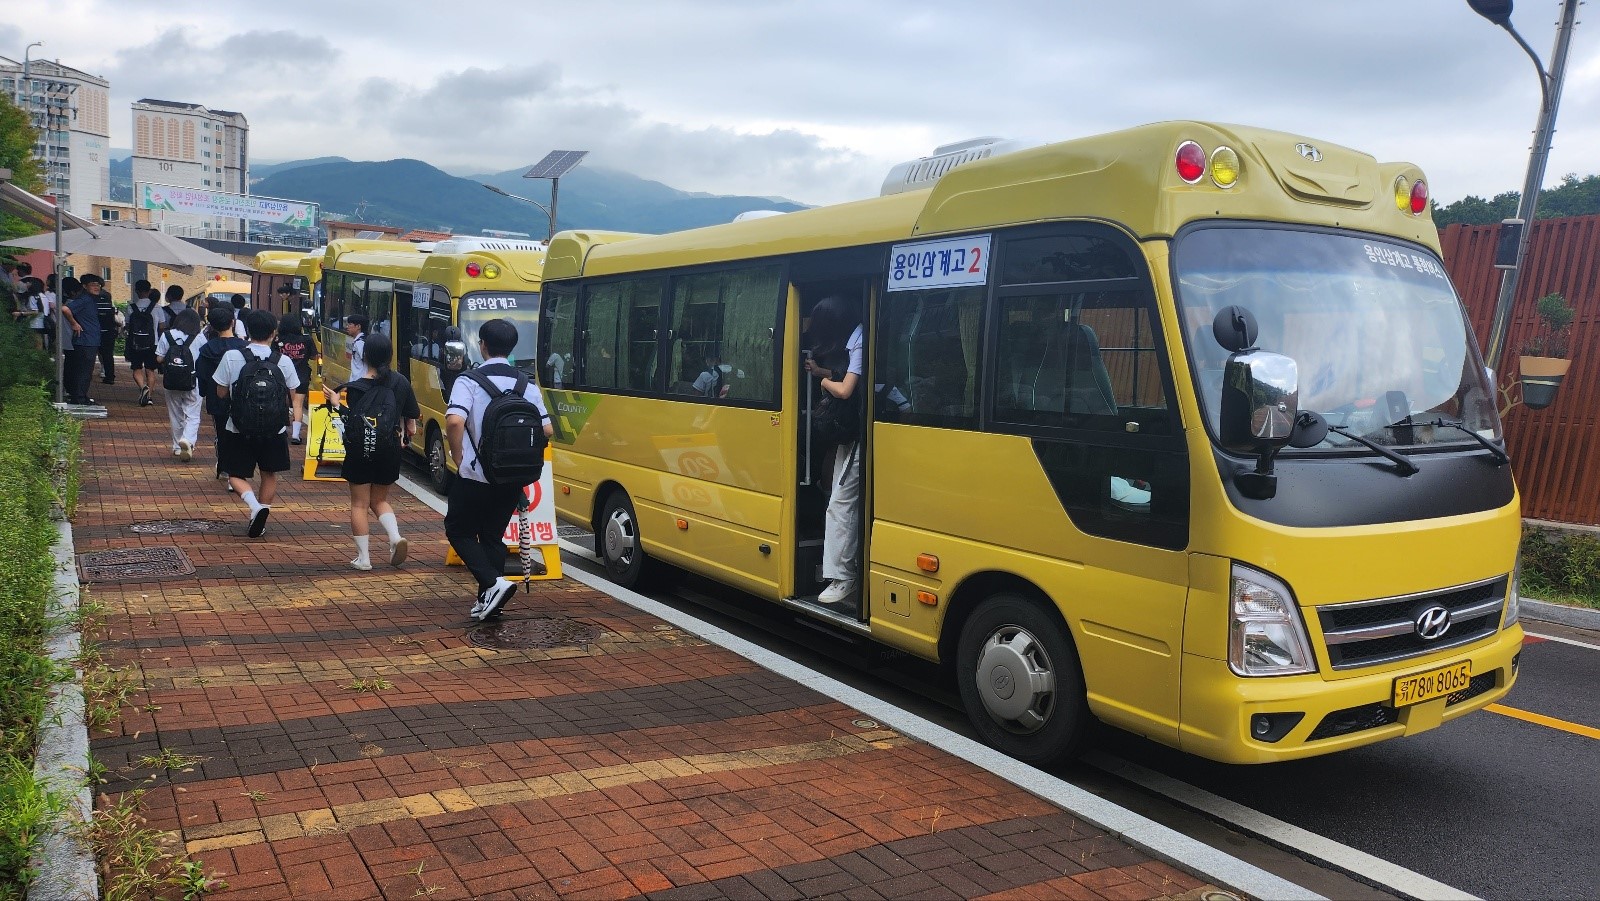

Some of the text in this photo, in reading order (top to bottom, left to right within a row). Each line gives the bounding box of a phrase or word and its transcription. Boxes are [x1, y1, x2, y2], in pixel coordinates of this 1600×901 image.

[159, 162, 173, 172] 101
[894, 247, 981, 281] 용인삼계고 2
[1363, 244, 1444, 279] 용인삼계고 통학버스
[467, 297, 518, 311] 용인삼계고
[557, 401, 590, 414] COUNTY
[1399, 665, 1467, 702] 경기 78아 8065
